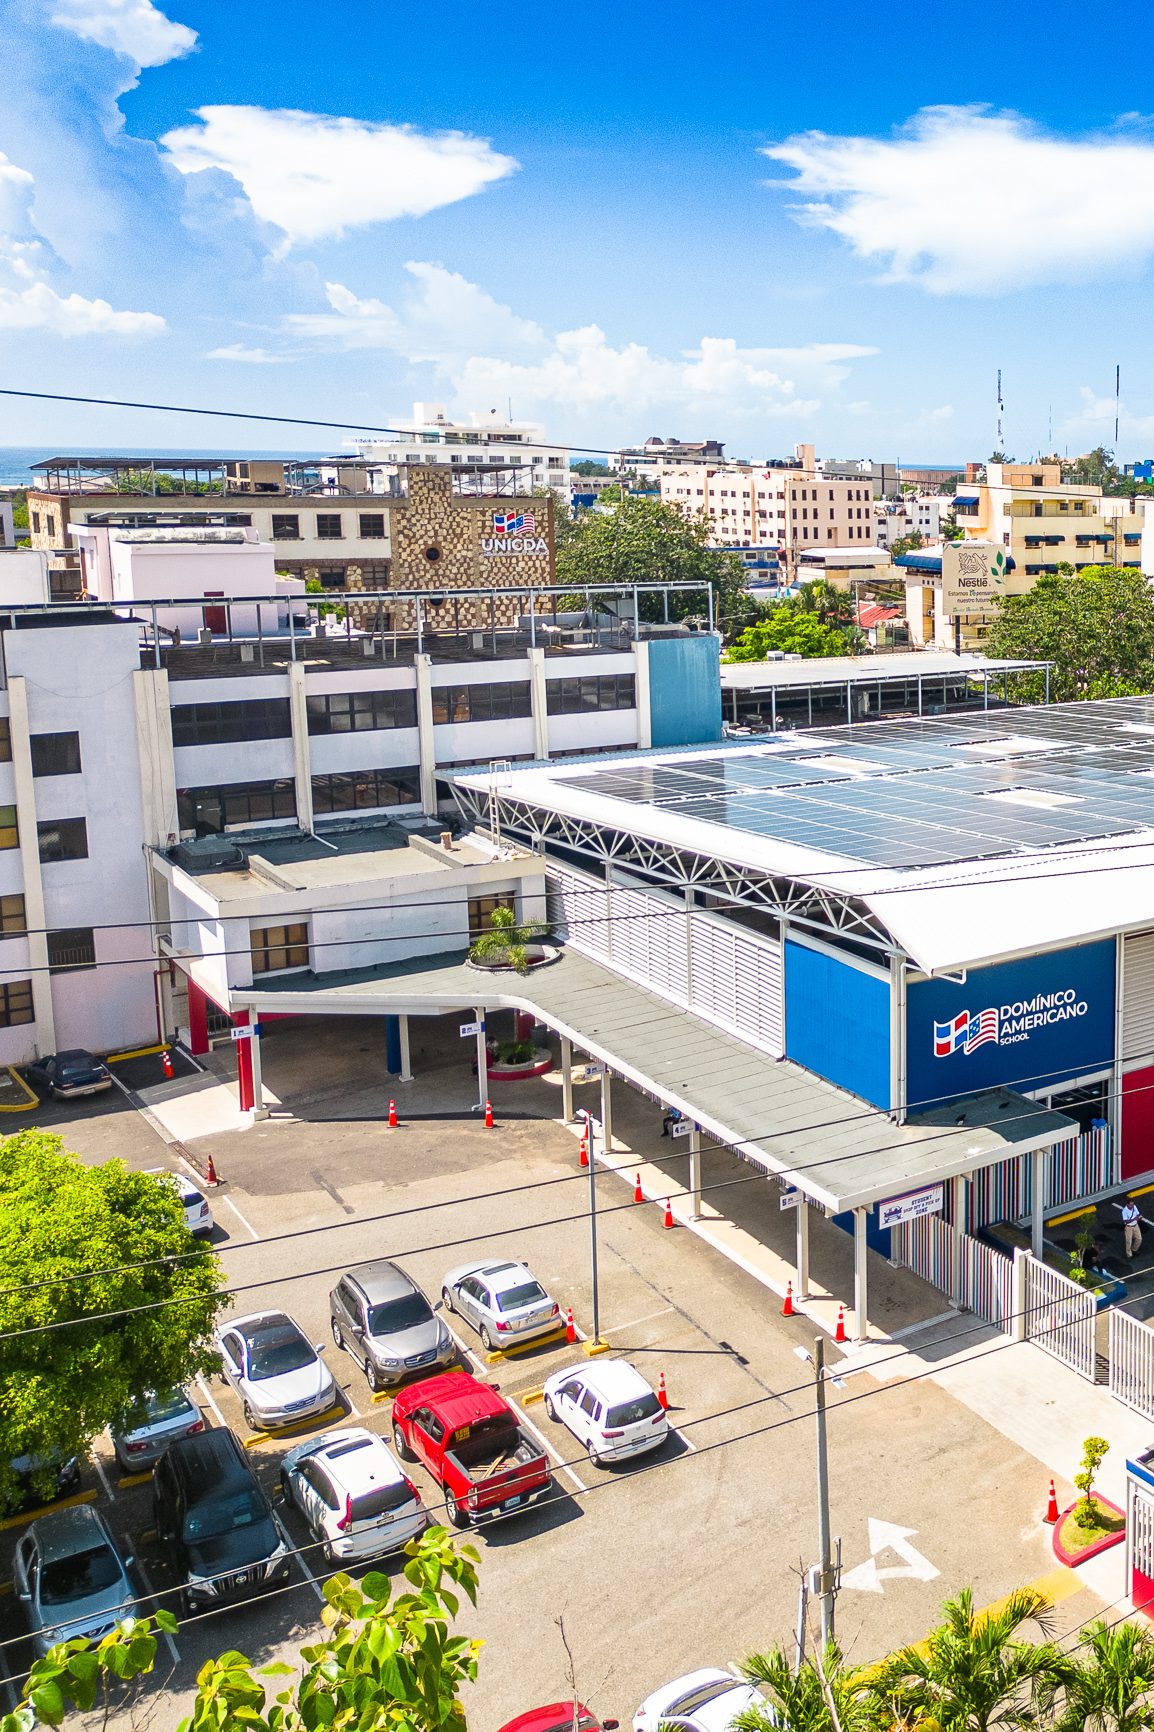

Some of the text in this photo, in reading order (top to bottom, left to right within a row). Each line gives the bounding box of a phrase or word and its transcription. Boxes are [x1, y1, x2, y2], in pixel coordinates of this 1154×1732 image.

[481, 538, 549, 551] UNICDA
[958, 577, 988, 588] Nestlé
[1000, 989, 1076, 1020] DOMÍNICO
[1000, 1001, 1088, 1036] AMERICANO
[1000, 1032, 1030, 1046] SCHOOL
[911, 1194, 933, 1206] STUDENT
[915, 1206, 928, 1215] ZONE
